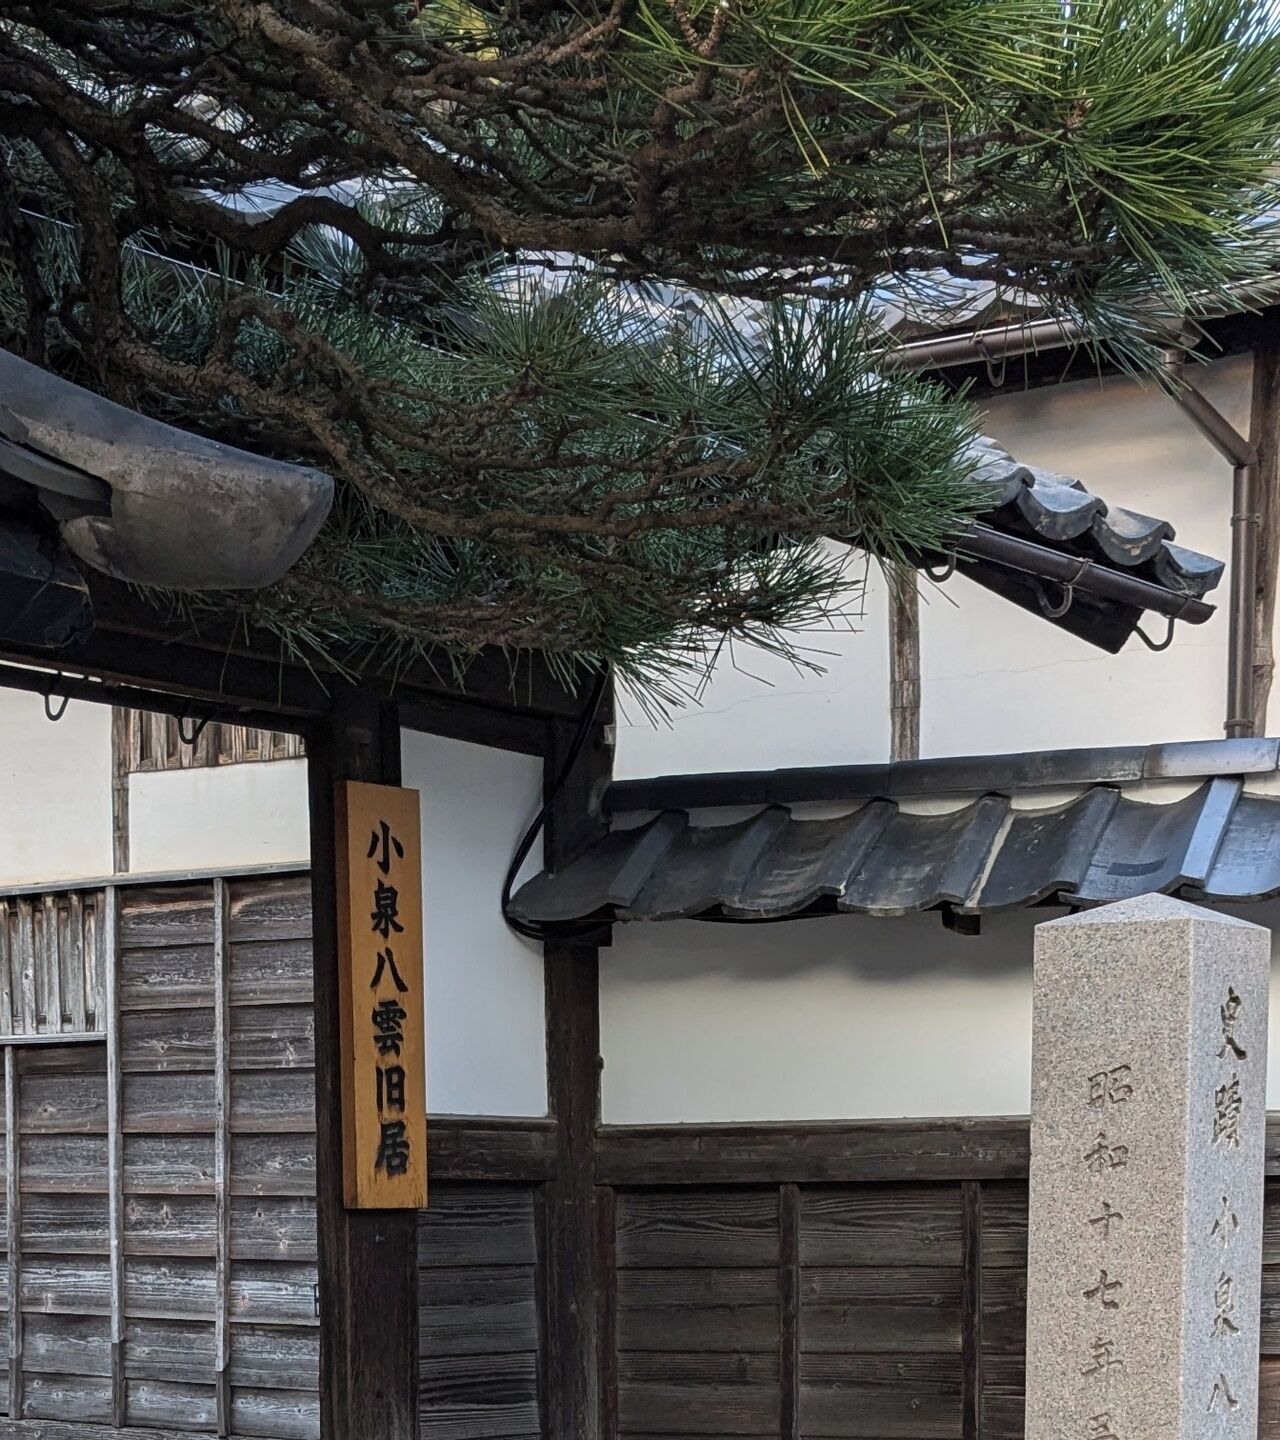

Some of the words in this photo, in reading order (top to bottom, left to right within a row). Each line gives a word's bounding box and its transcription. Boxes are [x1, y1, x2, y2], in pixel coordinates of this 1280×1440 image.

[367, 820, 410, 1178] 小泉八雲旧居
